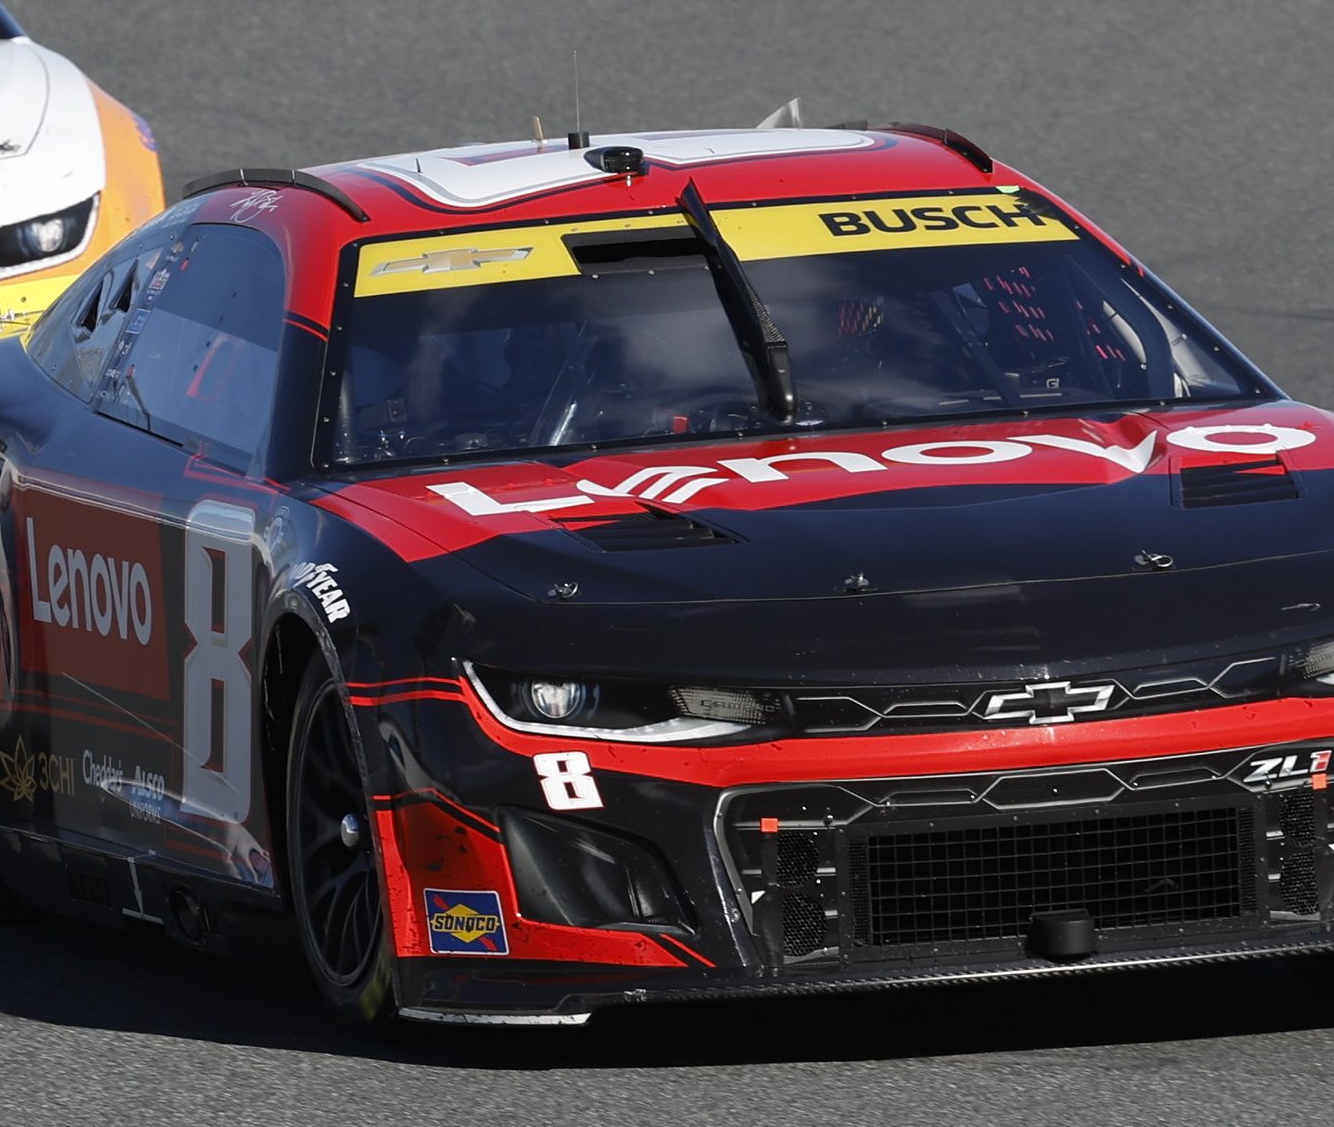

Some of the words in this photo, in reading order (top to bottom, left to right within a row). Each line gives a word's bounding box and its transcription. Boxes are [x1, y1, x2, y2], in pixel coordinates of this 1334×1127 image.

[817, 204, 1047, 237] BUSCH
[425, 423, 1317, 517] Lenovo
[25, 516, 152, 646] Lenovo
[179, 498, 256, 824] 8
[37, 750, 76, 796] 3CHI
[532, 750, 605, 811] 8
[1243, 750, 1333, 783] ZL1
[433, 914, 497, 933] SUNOCO
